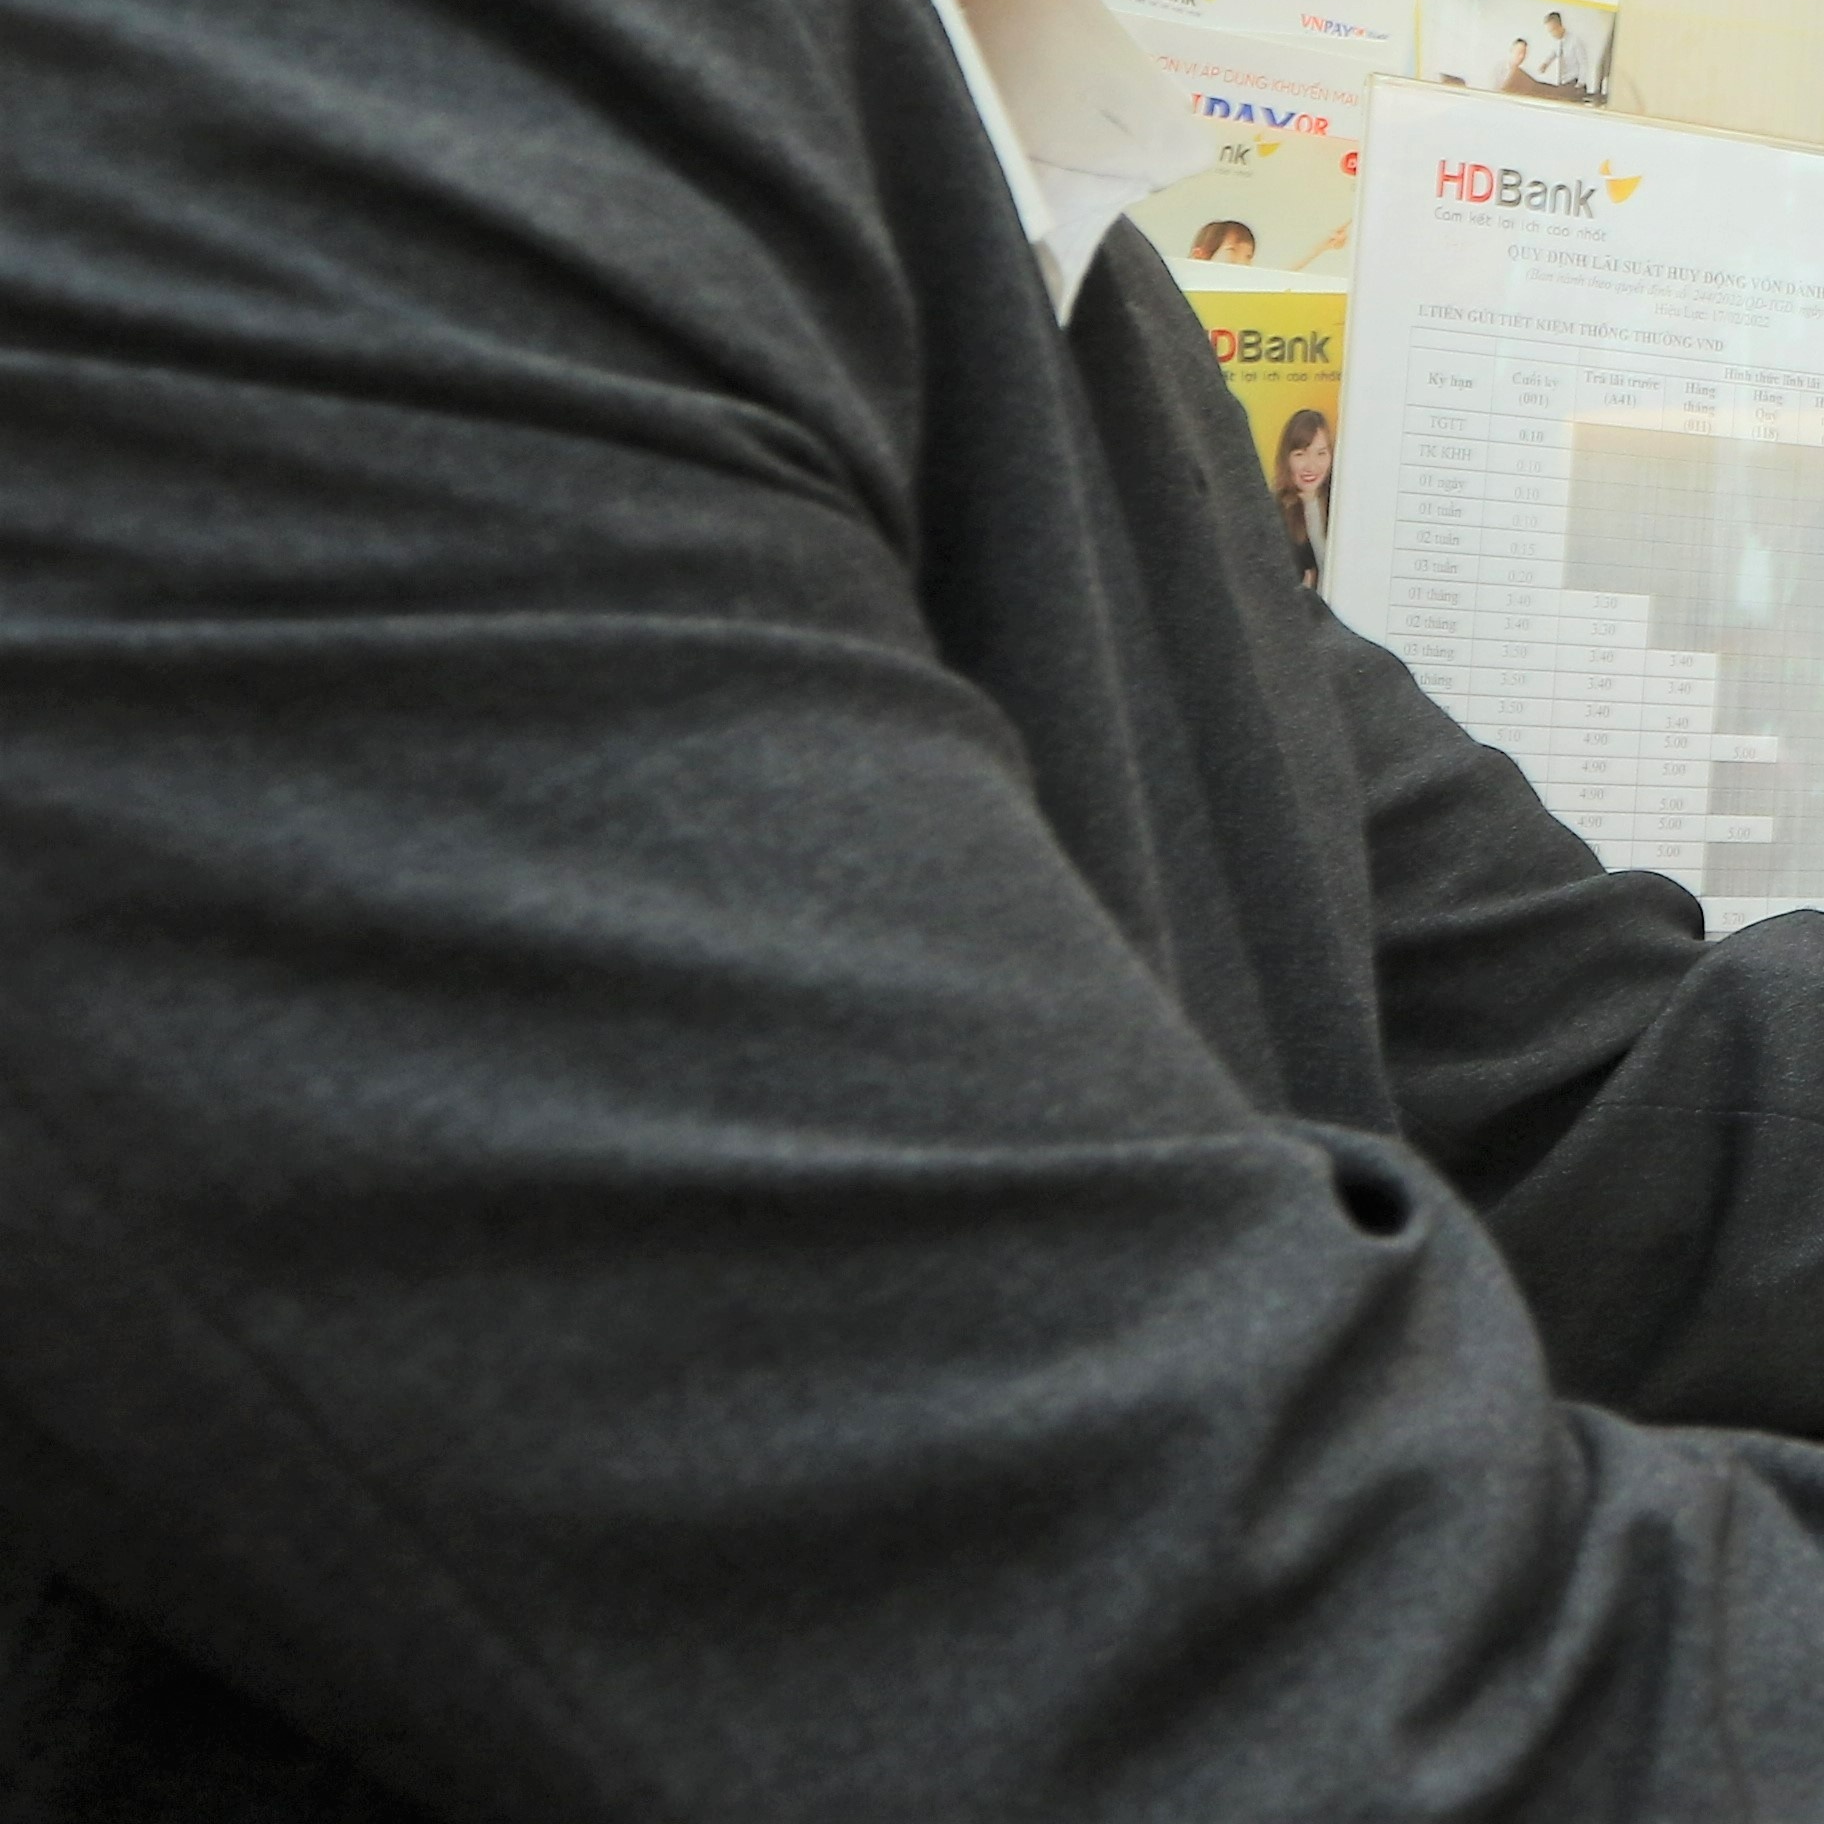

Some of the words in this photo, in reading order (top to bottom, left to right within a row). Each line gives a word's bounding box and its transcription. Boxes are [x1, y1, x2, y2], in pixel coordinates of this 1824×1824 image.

[1436, 159, 1598, 218] HDBank
[1508, 244, 1548, 262] QUY
[1209, 329, 1331, 363] DBank
